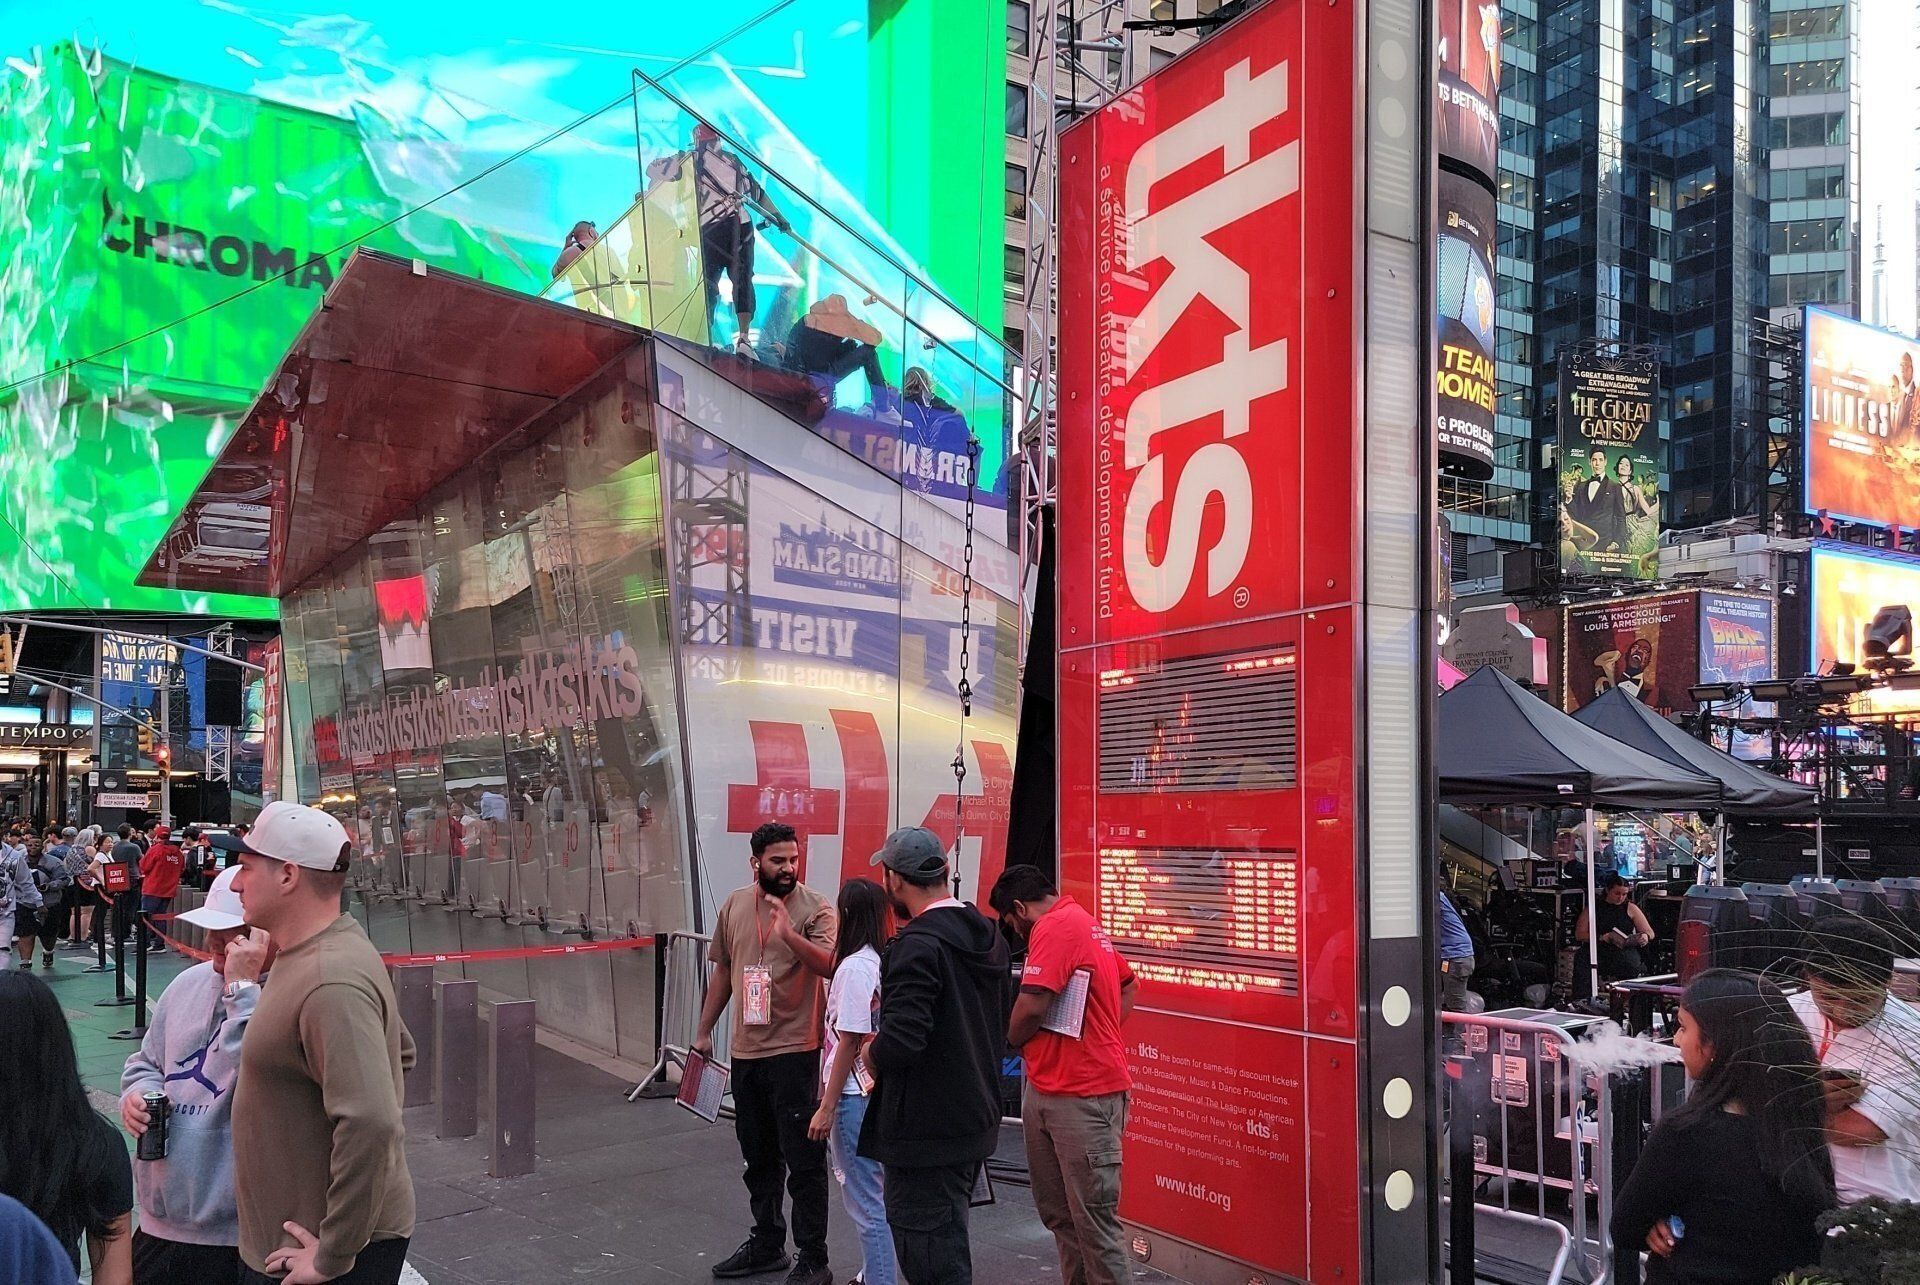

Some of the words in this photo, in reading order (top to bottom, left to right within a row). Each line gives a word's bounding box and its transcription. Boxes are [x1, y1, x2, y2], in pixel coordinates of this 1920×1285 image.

[102, 186, 346, 290] CHROMA
[1098, 188, 1113, 275] service
[1098, 282, 1113, 306] of
[1098, 311, 1113, 397] theatre
[1581, 371, 1602, 379] GREAT
[1616, 375, 1650, 384] BROADWAY
[1589, 380, 1638, 390] EXTRAVAGANZA
[1572, 397, 1598, 417] THE
[1601, 399, 1652, 422] GREAT
[1811, 385, 1888, 438] LIONESS
[1438, 433, 1450, 443] OR
[1451, 435, 1472, 448] TEXT
[1581, 418, 1643, 441] GATSBY
[1098, 399, 1113, 561] development
[1098, 566, 1113, 619] fund
[1742, 603, 1760, 611] CHANGE
[1584, 621, 1609, 631] LOUIS
[1611, 608, 1660, 620] KNOCKOUT
[1707, 606, 1727, 614] MUSICAL
[1748, 611, 1767, 619] HISTORY
[1452, 658, 1479, 667] FRANCIS
[1489, 656, 1514, 665] DUFFY
[565, 821, 579, 853] 10
[1138, 1042, 1159, 1060] tkts
[1160, 1053, 1170, 1062] the
[1172, 1055, 1190, 1066] booth
[1192, 1058, 1201, 1068] for
[1203, 1062, 1238, 1077] same-day
[1239, 1068, 1271, 1083] discount
[1143, 1066, 1188, 1084] Off-Broadway,
[1189, 1075, 1209, 1088] Music
[1212, 1081, 1216, 1089] &
[1219, 1081, 1242, 1095] Dance
[1243, 1087, 1290, 1105] Productions.
[1145, 1084, 1156, 1093] the
[1157, 1087, 1195, 1102] cooperation
[1196, 1095, 1205, 1104] of
[1206, 1097, 1219, 1108] The
[1220, 1101, 1247, 1115] League
[1248, 1106, 1256, 1116] of
[1258, 1109, 1294, 1126] American
[1134, 1115, 1141, 1124] of
[1142, 1116, 1167, 1130] Theatre
[1168, 1122, 1212, 1143] Development
[1243, 1144, 1290, 1163] not-for-profit
[1172, 1106, 1185, 1117] The
[1186, 1110, 1200, 1123] City
[1201, 1114, 1209, 1123] of
[1210, 1116, 1225, 1127] New
[1228, 1120, 1244, 1132] York
[1246, 1119, 1271, 1139] tkts
[1272, 1132, 1279, 1141] is
[1125, 1130, 1164, 1147] organization
[1164, 1139, 1173, 1150] for
[1175, 1142, 1186, 1153] the
[1187, 1147, 1224, 1166] performing
[1225, 1157, 1241, 1169] arts.
[1155, 1173, 1231, 1212] www.tdf.org
